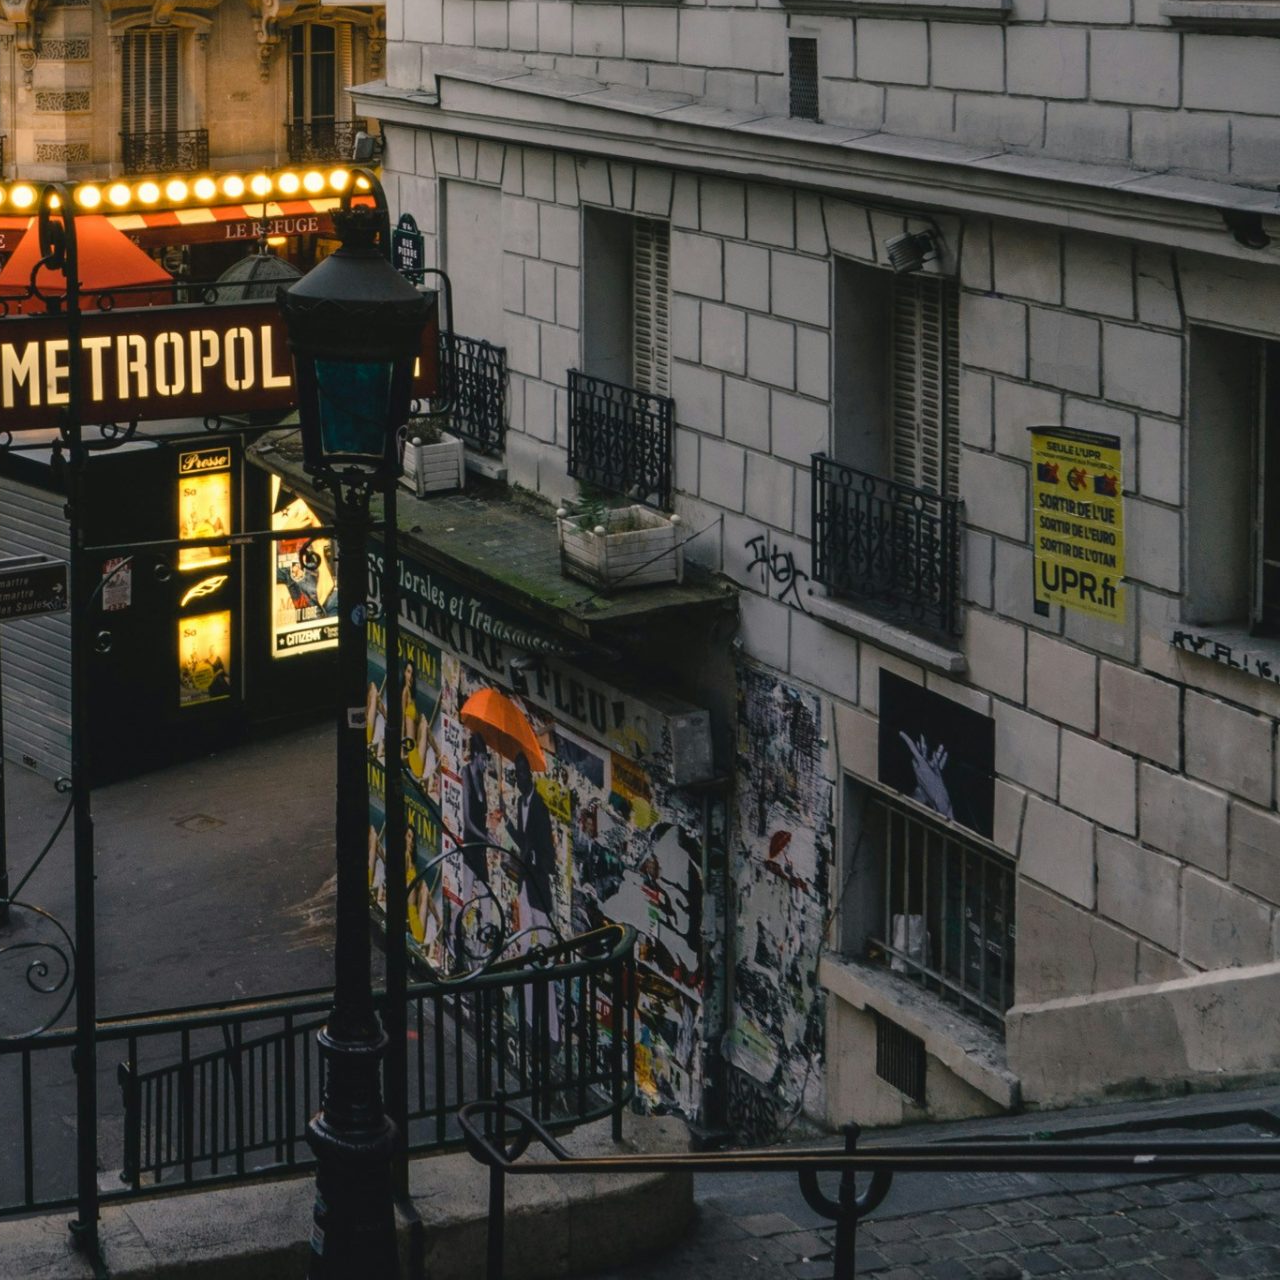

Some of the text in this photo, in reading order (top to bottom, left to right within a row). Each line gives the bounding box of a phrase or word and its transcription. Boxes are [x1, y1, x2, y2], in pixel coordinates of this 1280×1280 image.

[225, 224, 247, 239] LE
[1046, 441, 1101, 460] SEULE L'UPR
[1039, 493, 1115, 524] SORTIR DE L'UE
[1039, 516, 1116, 546] SORTIR DE L'EURO
[1040, 537, 1116, 569] SORTIR DE L'OTAN
[397, 559, 445, 610] lorales
[1042, 561, 1116, 609] UPR.fr
